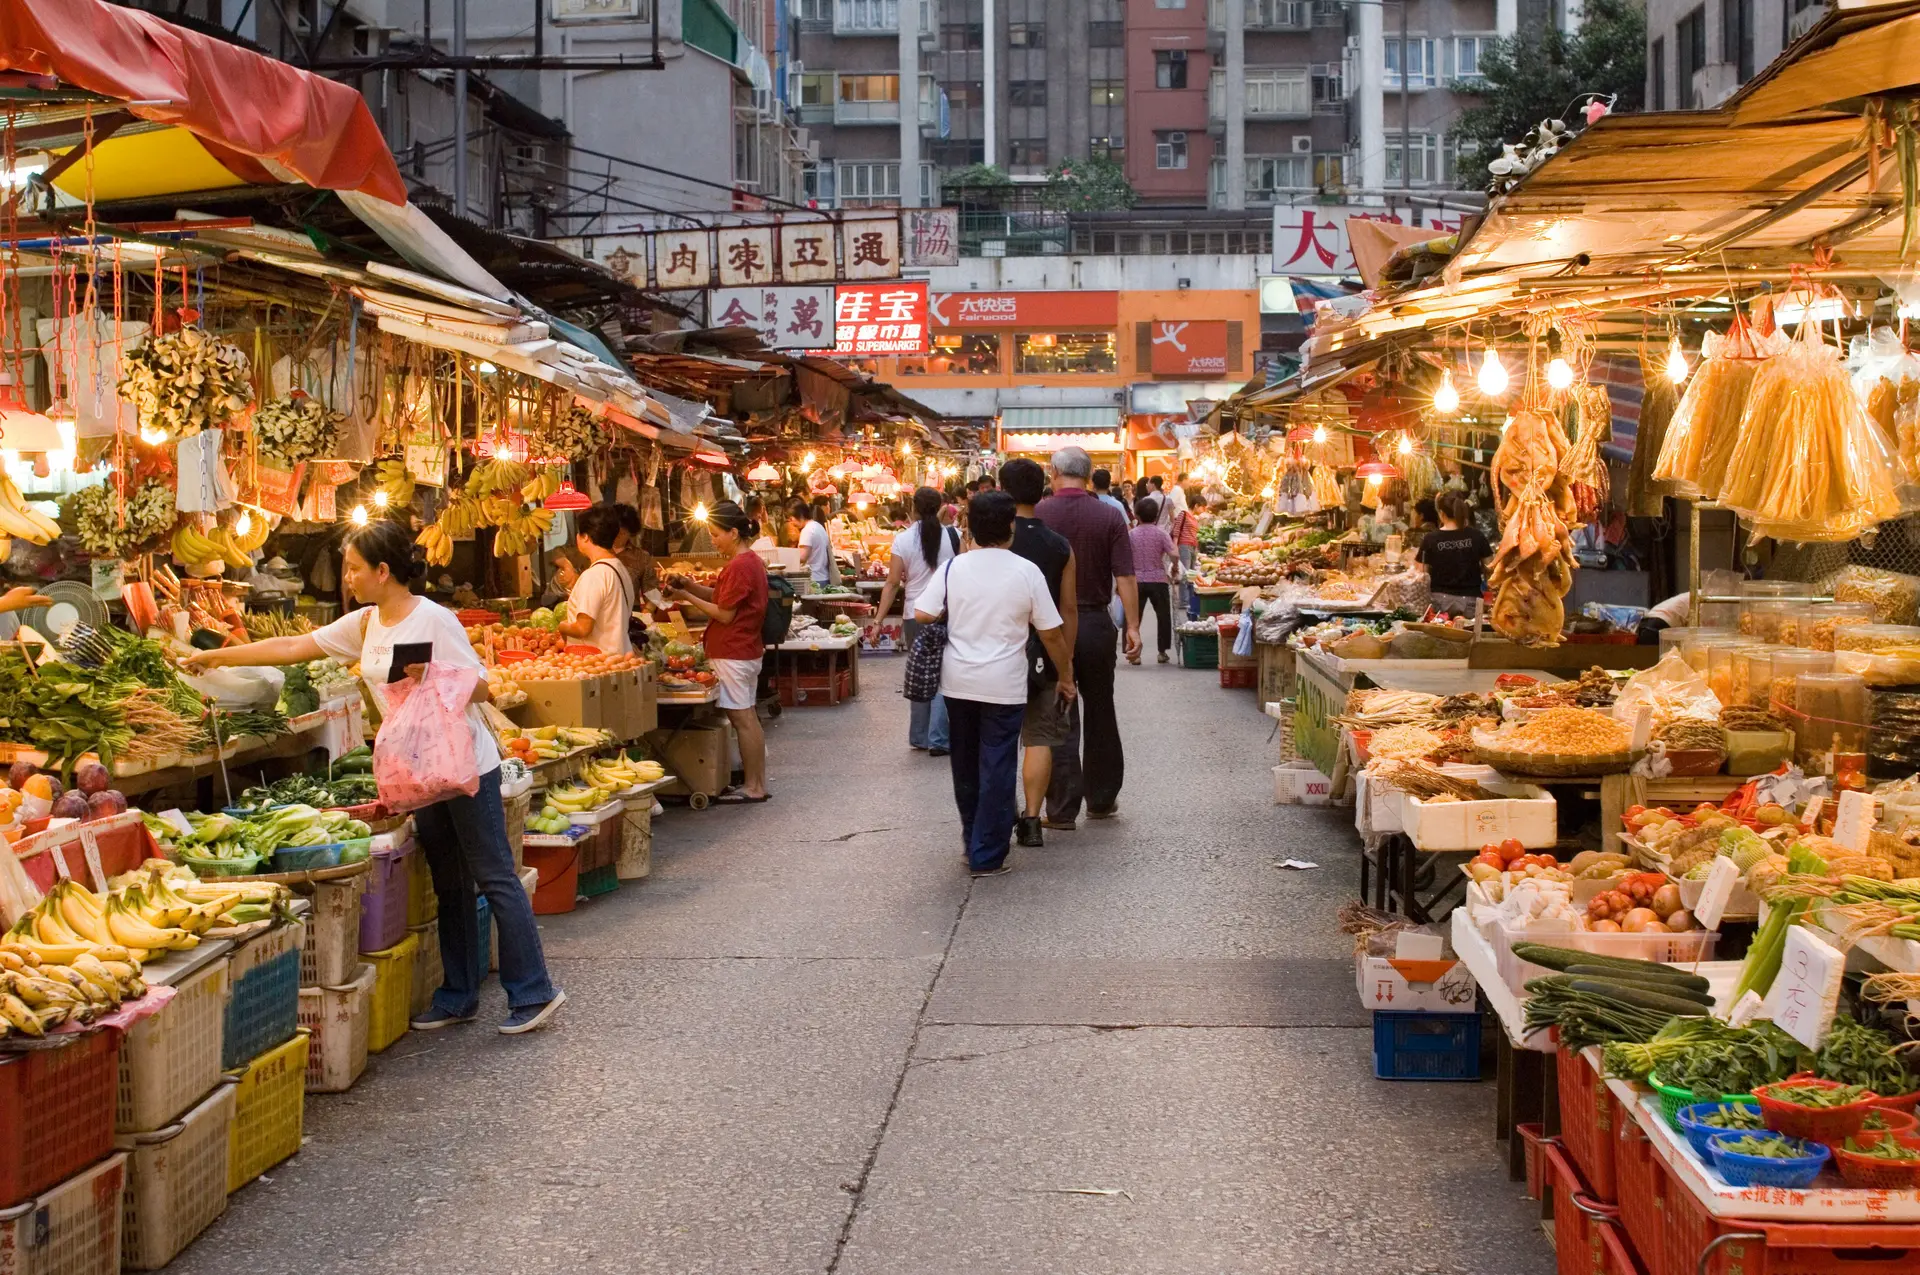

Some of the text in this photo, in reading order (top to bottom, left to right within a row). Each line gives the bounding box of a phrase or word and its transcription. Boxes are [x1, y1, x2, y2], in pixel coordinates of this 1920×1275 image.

[958, 297, 1017, 313] 大快活
[958, 313, 1017, 321] Fairwood
[856, 340, 921, 352] SUPERMARKET
[1187, 357, 1226, 368] 大快活
[1306, 783, 1328, 794] XXL
